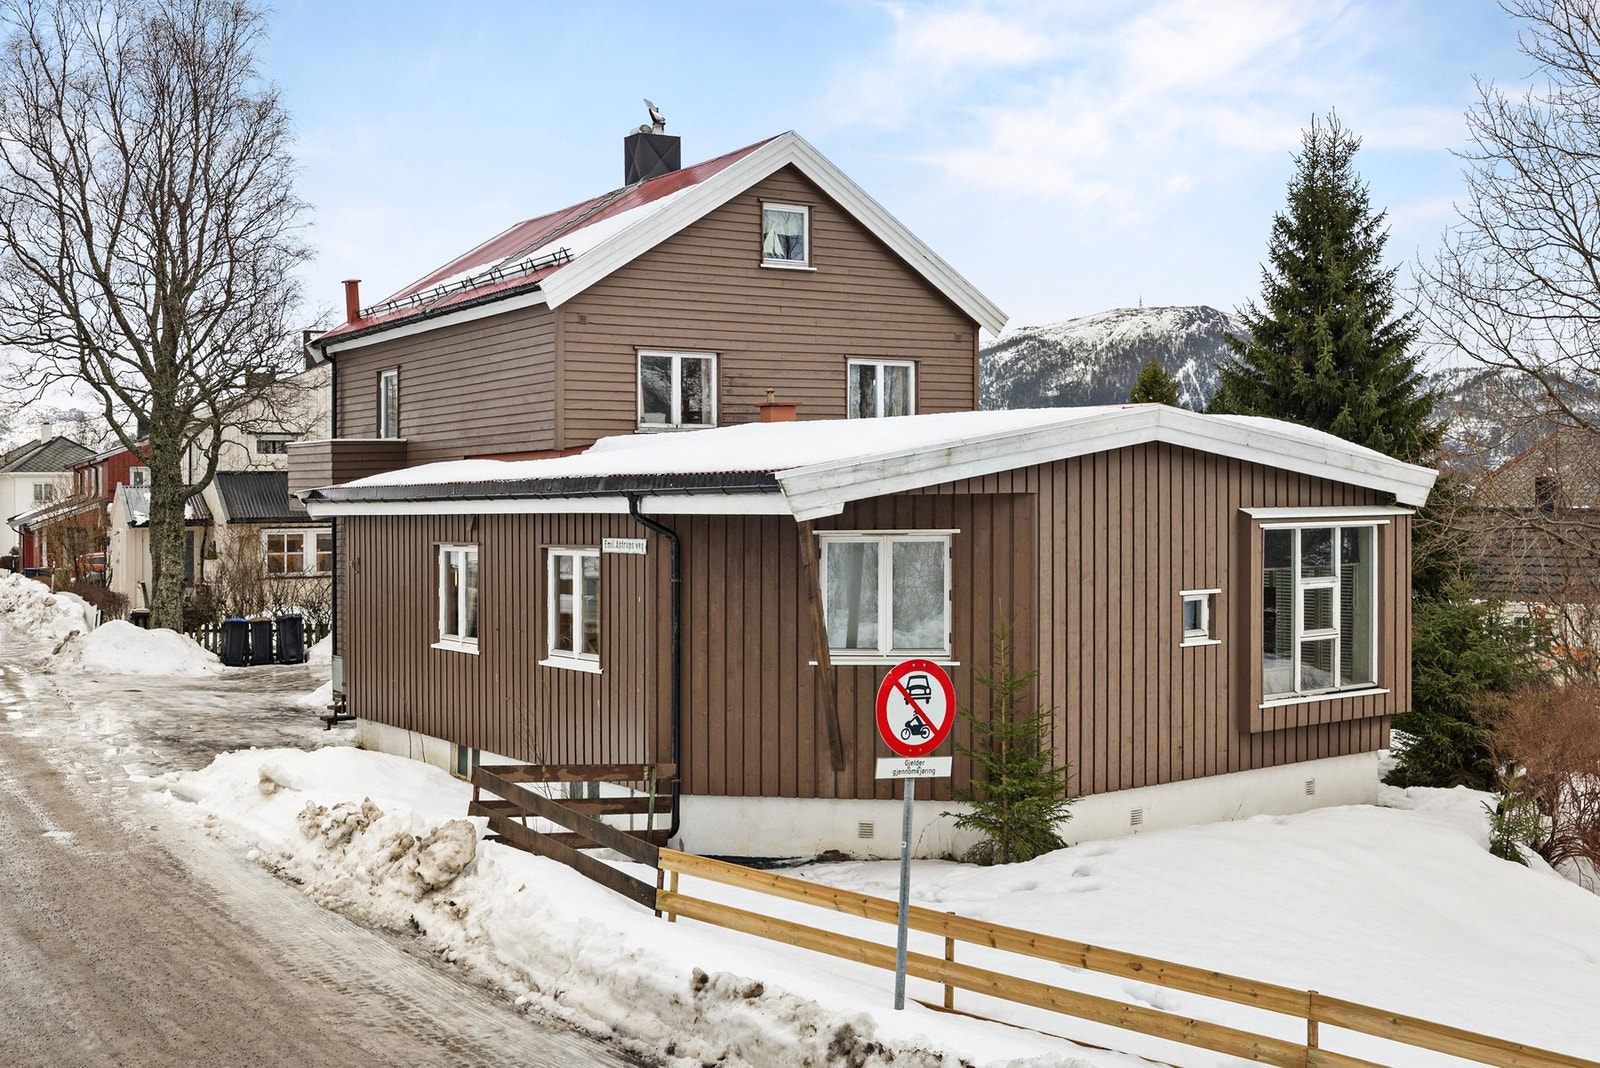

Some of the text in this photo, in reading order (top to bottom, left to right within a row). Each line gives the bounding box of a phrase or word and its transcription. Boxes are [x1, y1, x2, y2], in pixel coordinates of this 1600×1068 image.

[616, 540, 635, 551] Astrups
[904, 759, 925, 769] Gjelder
[892, 767, 936, 777] gjennomkjøring
